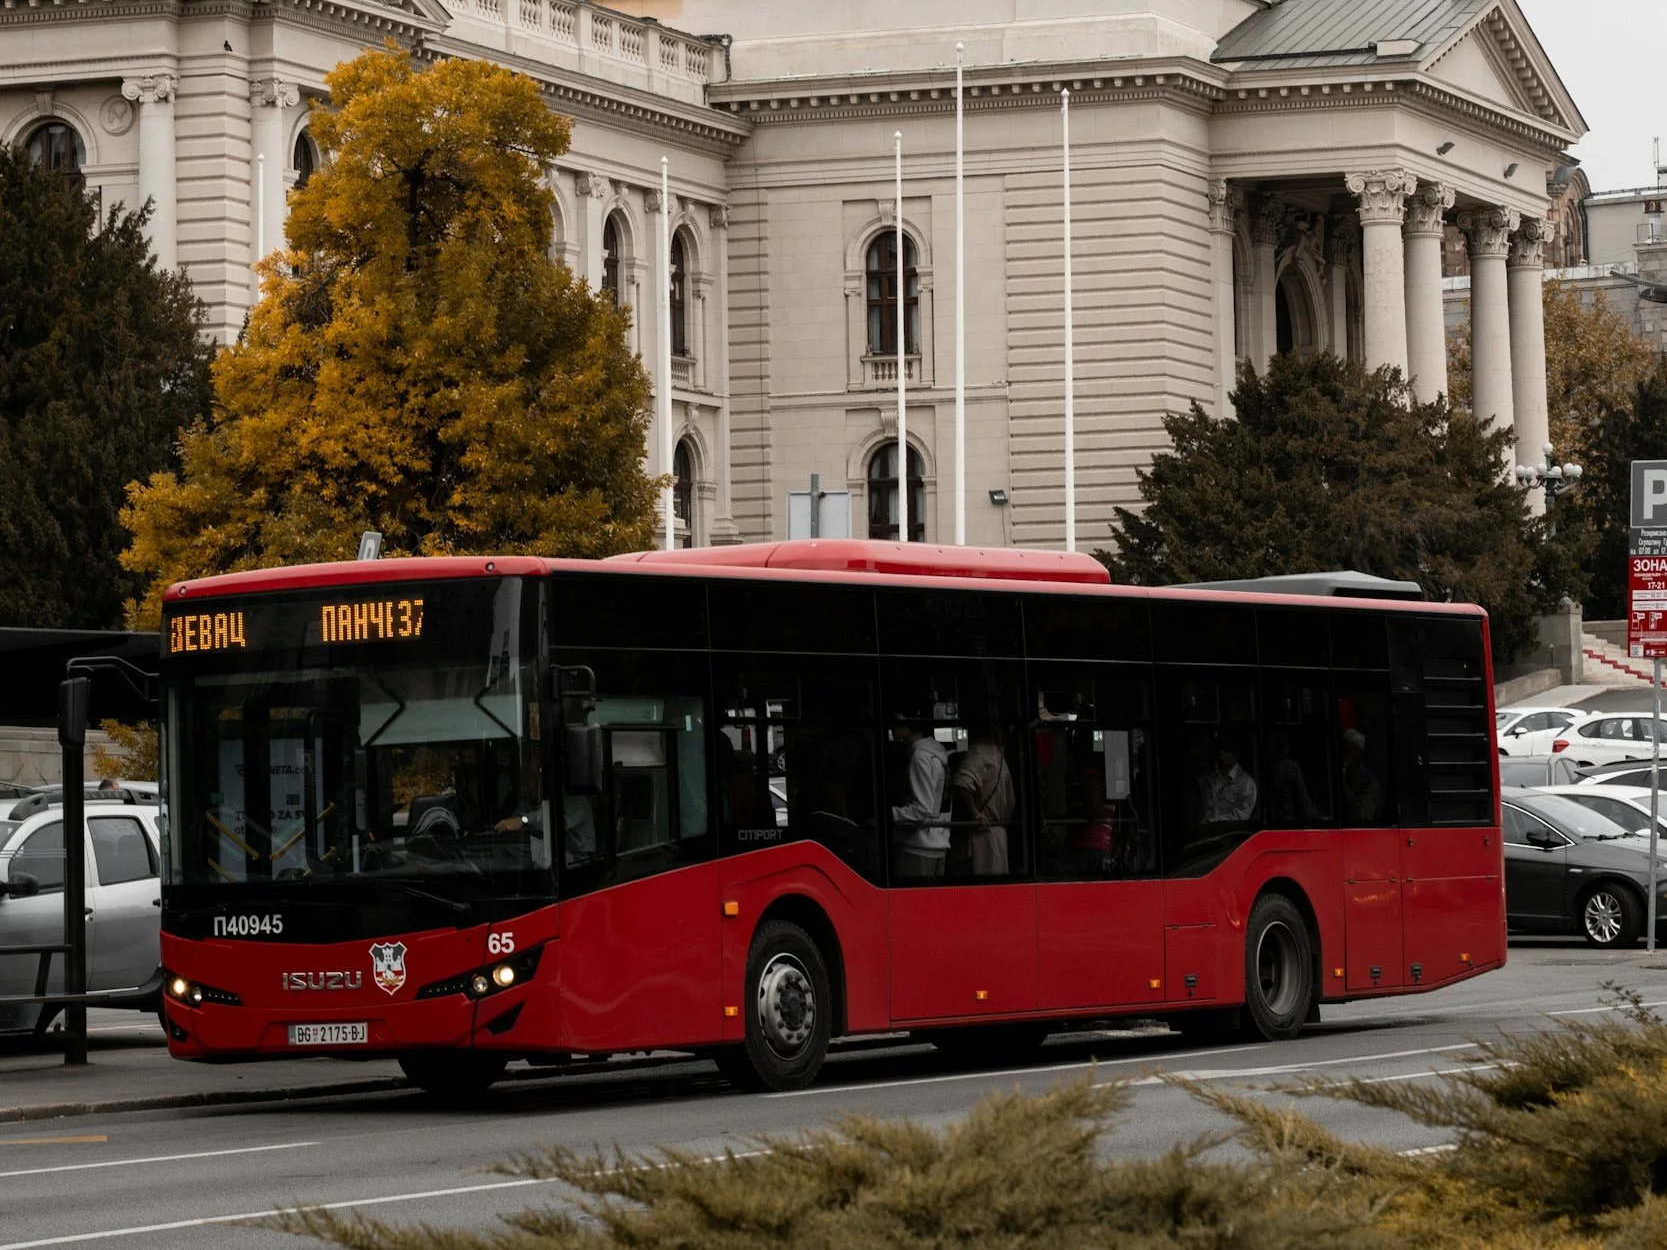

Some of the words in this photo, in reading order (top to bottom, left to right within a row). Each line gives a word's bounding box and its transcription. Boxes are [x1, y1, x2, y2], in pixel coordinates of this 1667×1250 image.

[1633, 559, 1667, 571] ЗОНА
[738, 829, 783, 840] CITIPORT
[213, 914, 283, 936] П40945
[488, 932, 515, 954] 65
[282, 971, 362, 991] ISUZU
